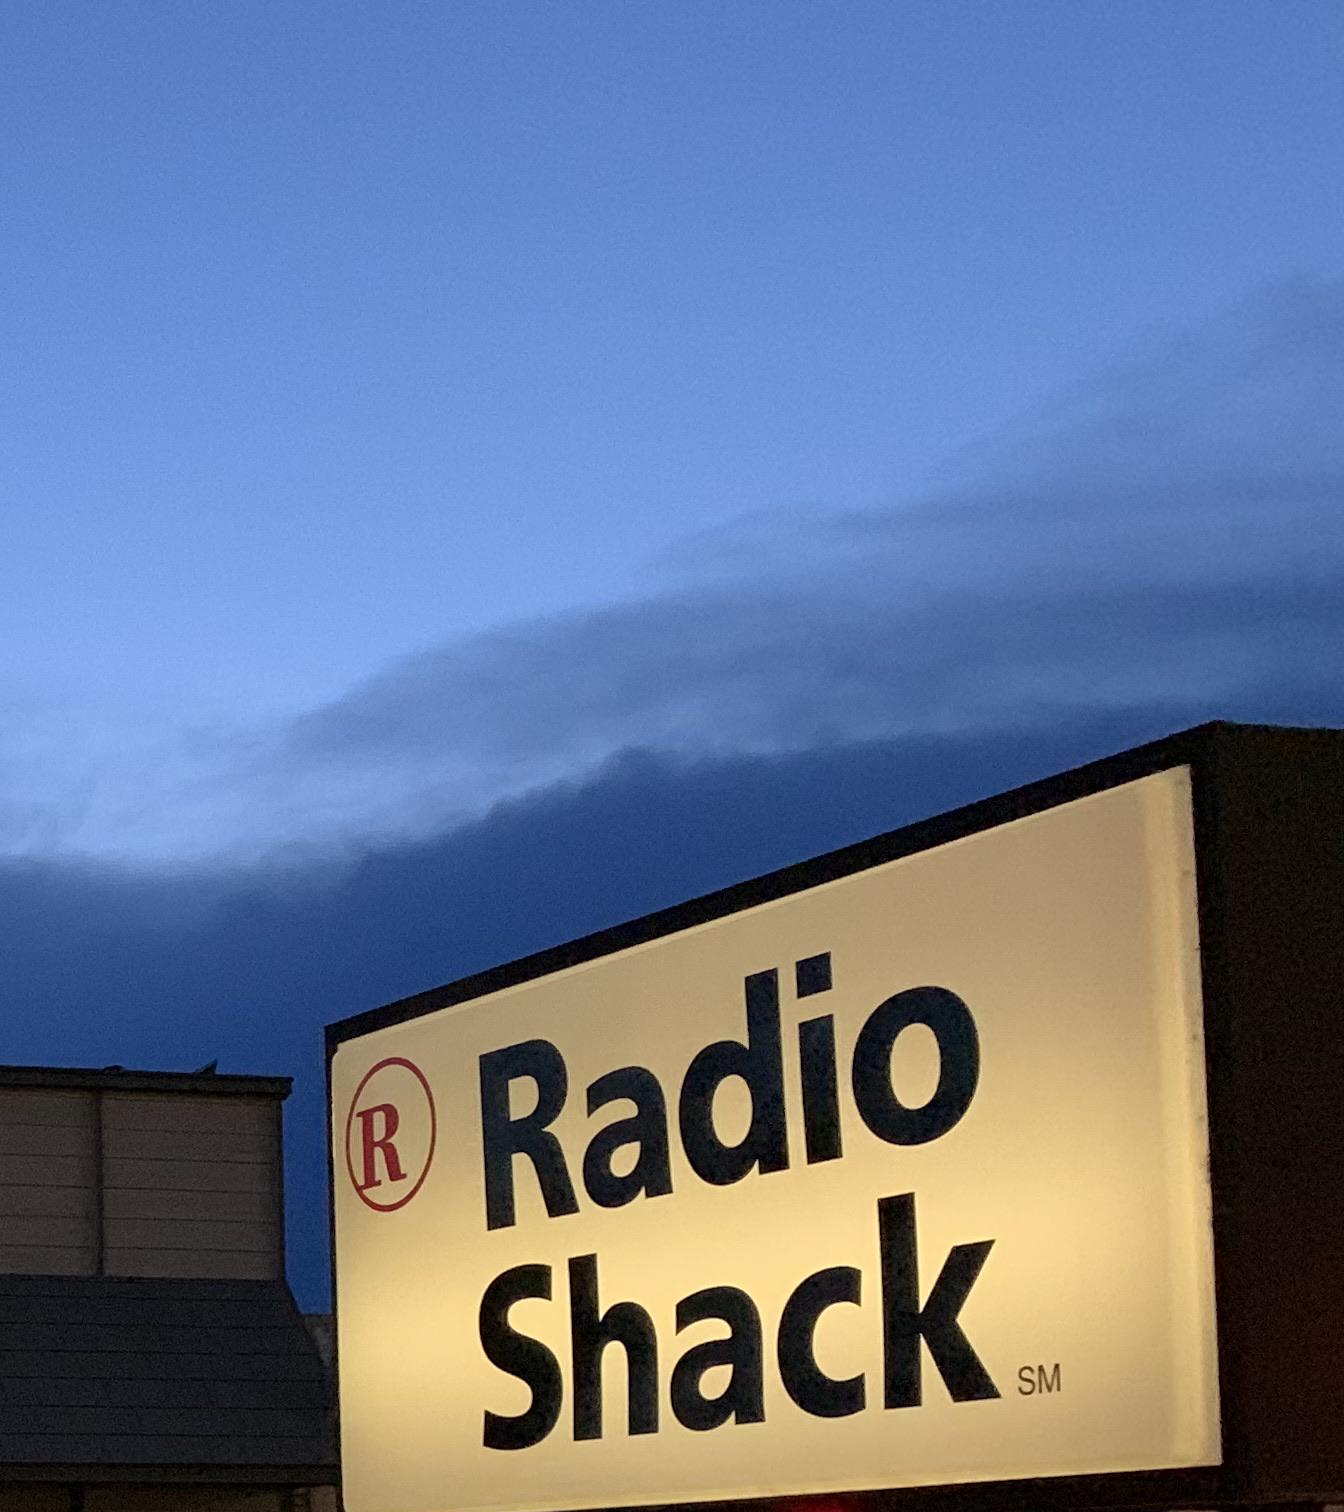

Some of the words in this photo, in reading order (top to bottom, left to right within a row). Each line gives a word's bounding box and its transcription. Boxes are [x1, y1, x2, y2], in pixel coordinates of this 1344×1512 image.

[478, 952, 980, 1231] Radio
[479, 1193, 1002, 1451] Shack
[1018, 1363, 1062, 1396] SM
